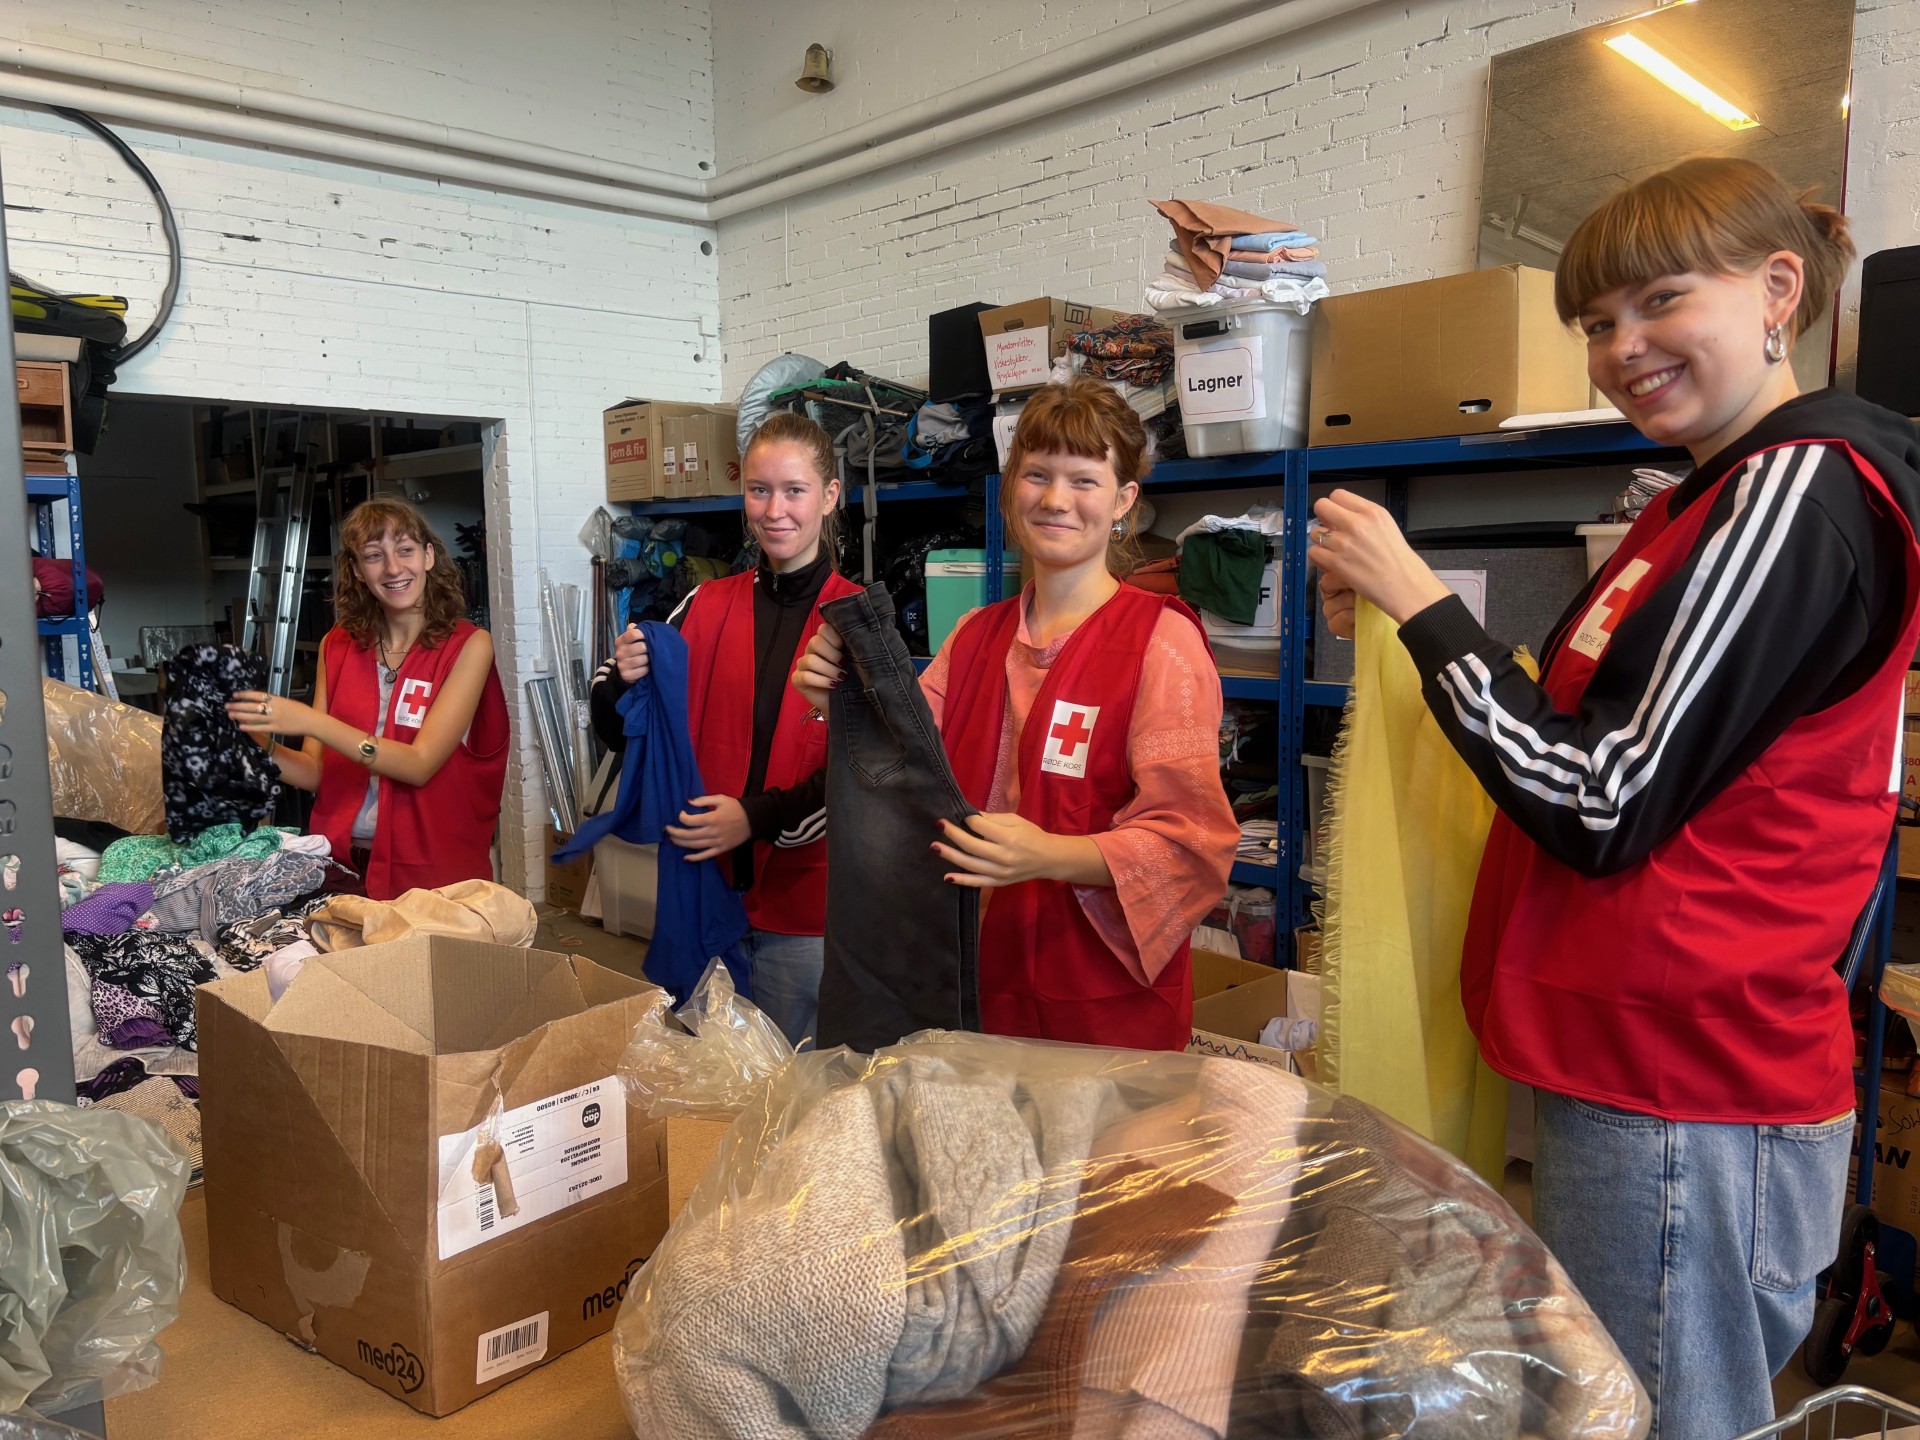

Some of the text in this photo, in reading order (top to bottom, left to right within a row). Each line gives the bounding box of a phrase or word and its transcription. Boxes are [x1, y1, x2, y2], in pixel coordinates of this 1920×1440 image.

[1188, 374, 1243, 393] Lagner
[610, 442, 645, 462] jem & fix
[1043, 757, 1082, 771] RØDE KORS
[583, 1112, 600, 1123] dao
[357, 1339, 418, 1384] med24
